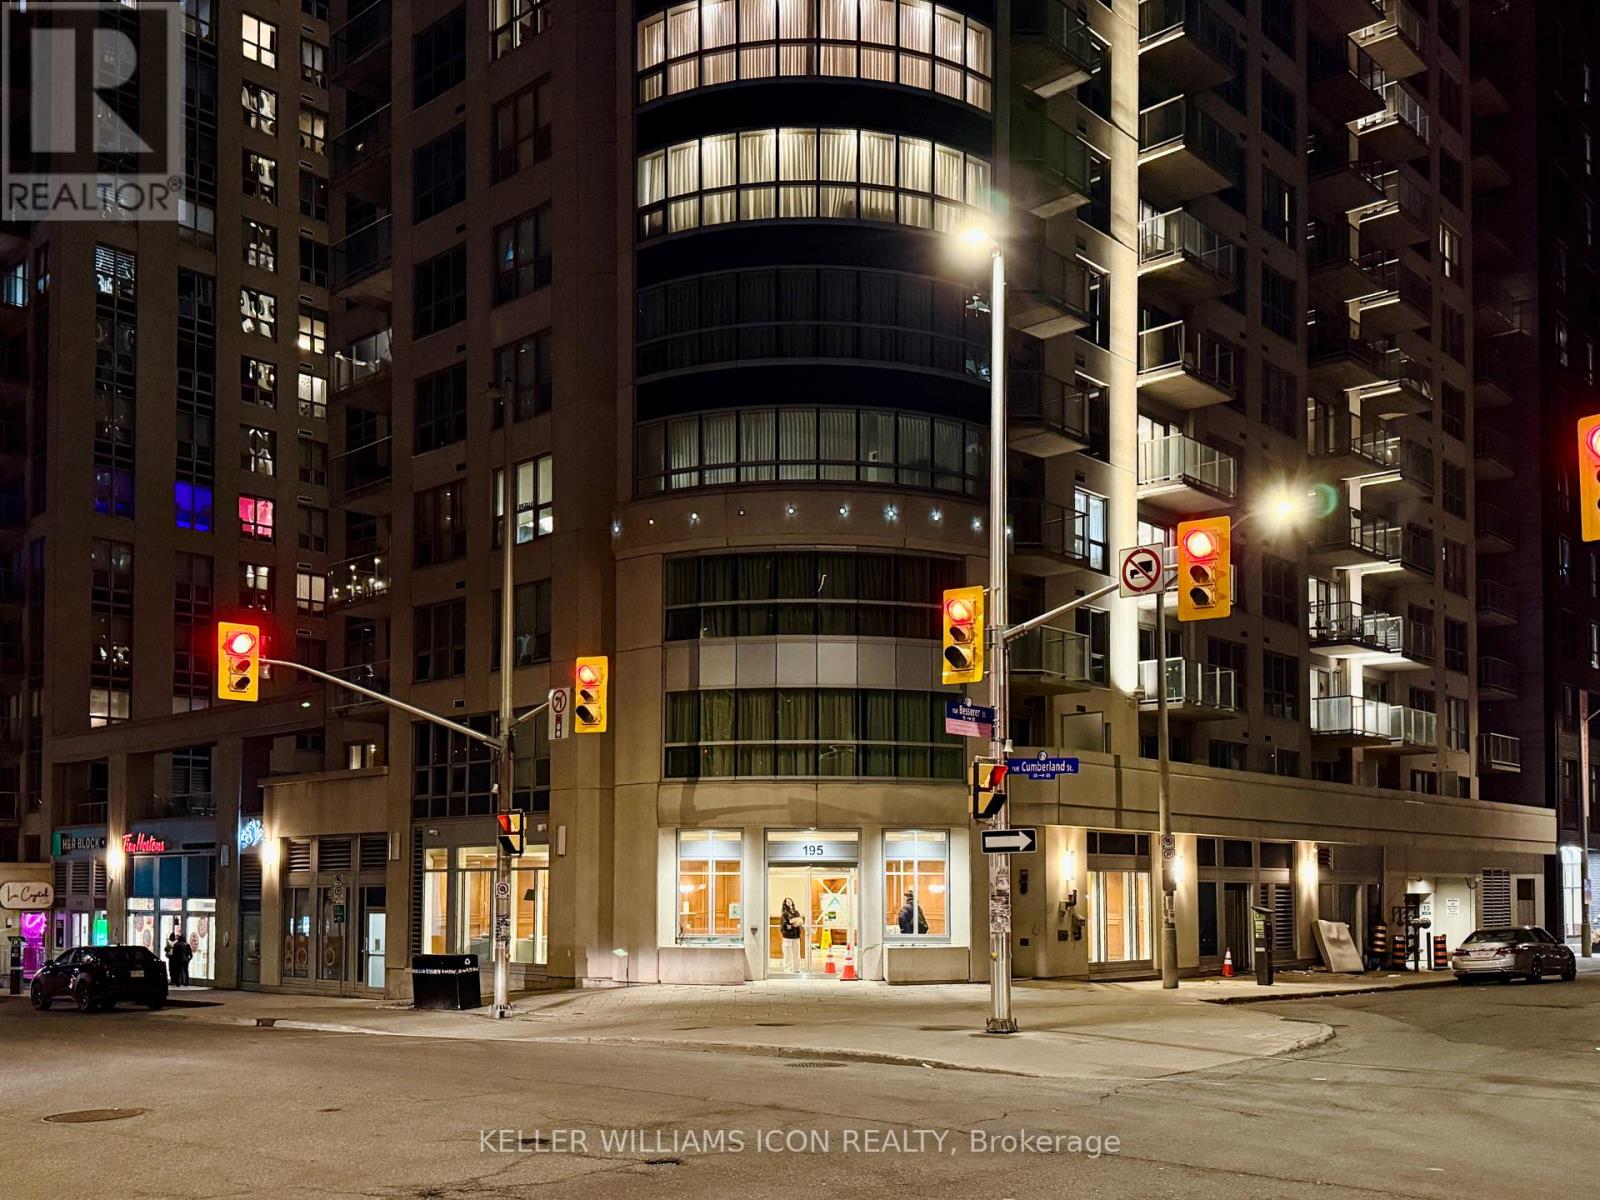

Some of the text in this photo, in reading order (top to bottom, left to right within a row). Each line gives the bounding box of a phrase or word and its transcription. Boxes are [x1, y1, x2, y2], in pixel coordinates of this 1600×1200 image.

[959, 704, 981, 717] Besserer
[1021, 760, 1066, 772] Cumberland
[1066, 763, 1074, 772] St.
[62, 837, 100, 850] H&R BLOCK
[122, 832, 165, 852] Tim Hortons
[802, 845, 824, 856] 195
